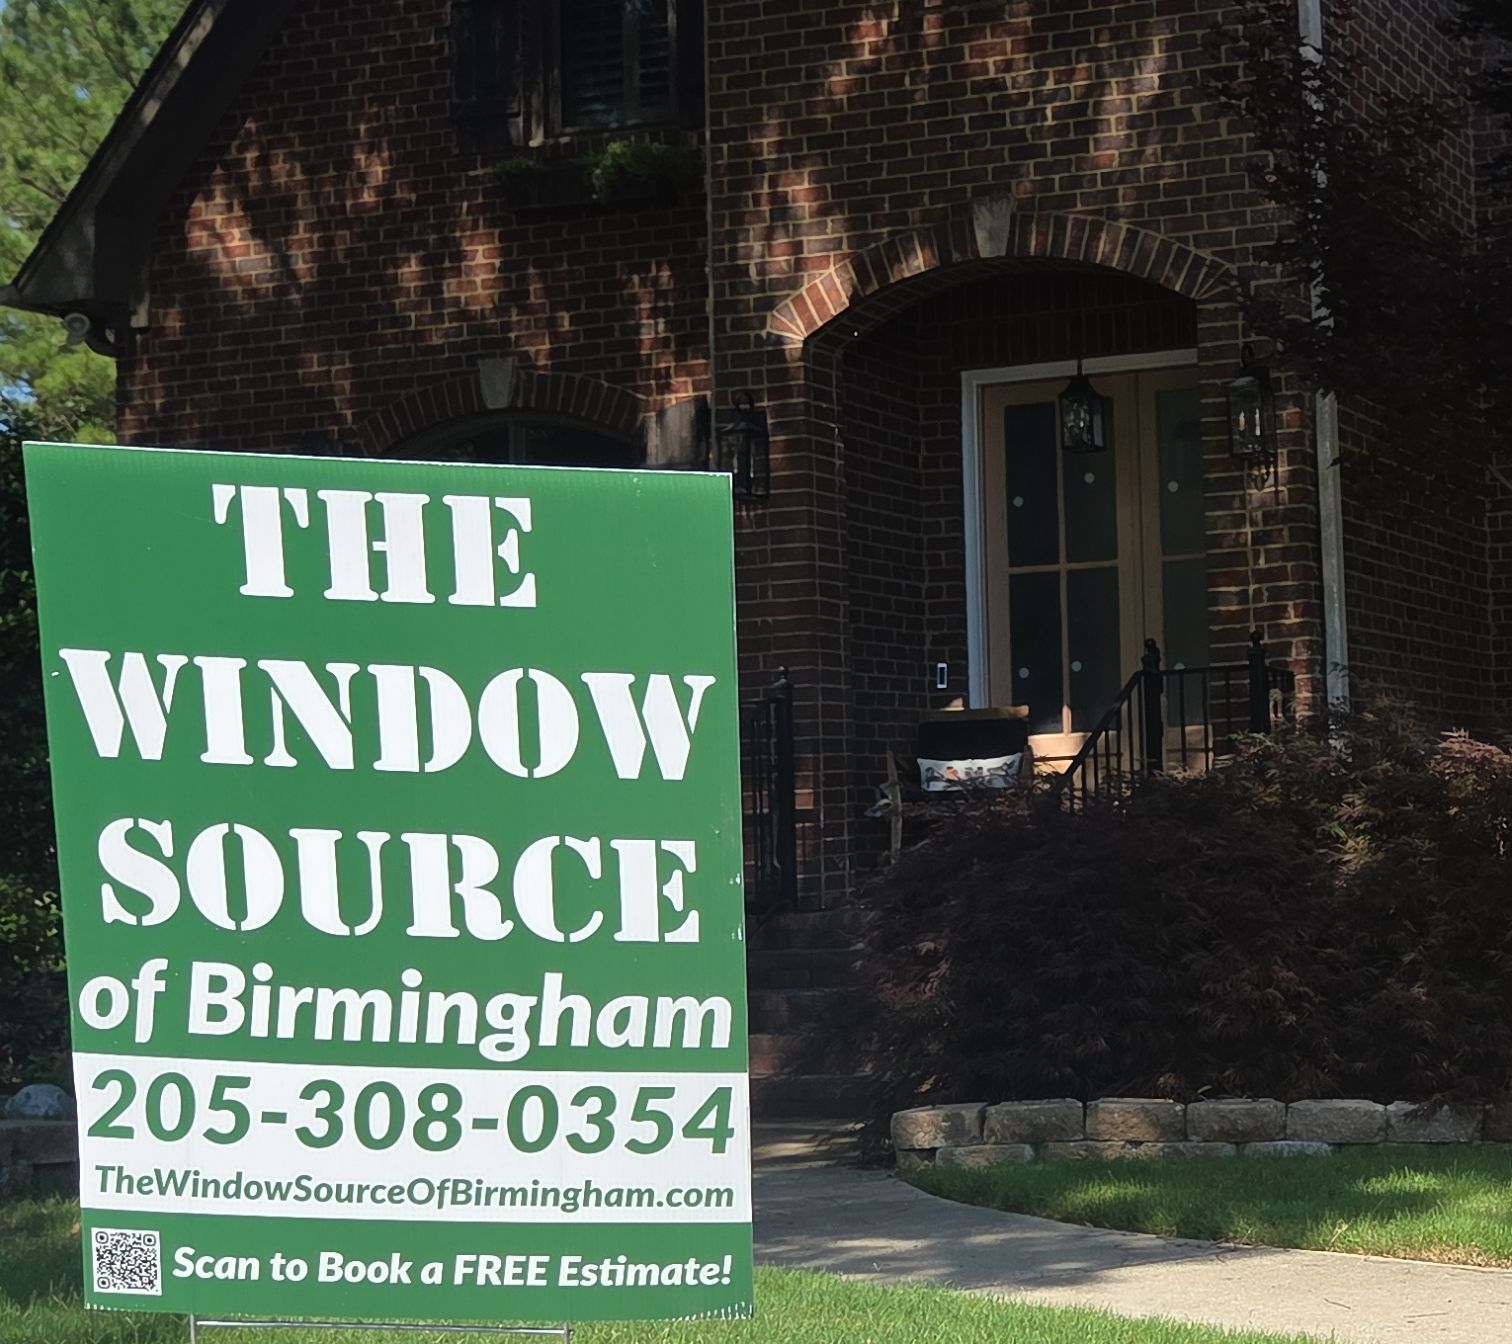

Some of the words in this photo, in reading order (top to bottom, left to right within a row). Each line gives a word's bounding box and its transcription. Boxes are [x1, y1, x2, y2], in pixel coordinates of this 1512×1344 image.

[212, 484, 537, 608] THE
[59, 648, 716, 781] WINDOW
[97, 817, 700, 944] SOURCE
[78, 958, 168, 1044] of
[188, 961, 732, 1063] Birmingham
[87, 1069, 735, 1155] 205-308-0354
[95, 1165, 735, 1213] TheWindowSourceOfBirmingham.com
[173, 1246, 260, 1281] Scan
[269, 1254, 308, 1282] to
[318, 1252, 412, 1285] Book
[420, 1261, 443, 1285] a
[454, 1254, 547, 1287] FREE
[558, 1255, 732, 1287] Estimate!
